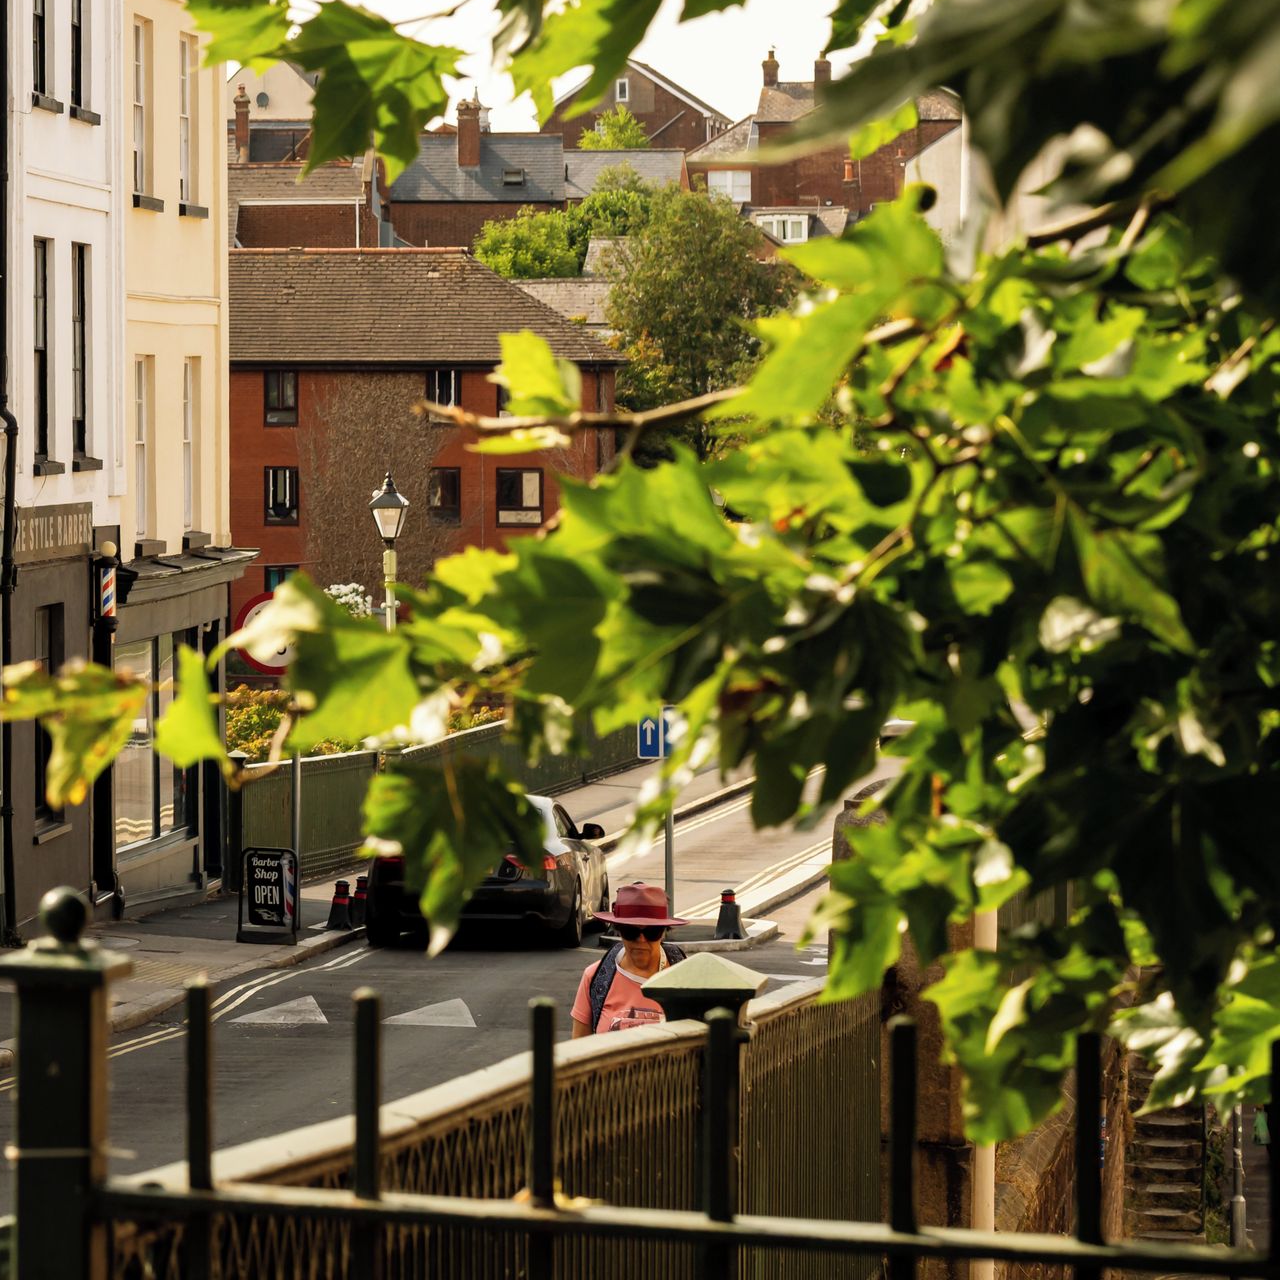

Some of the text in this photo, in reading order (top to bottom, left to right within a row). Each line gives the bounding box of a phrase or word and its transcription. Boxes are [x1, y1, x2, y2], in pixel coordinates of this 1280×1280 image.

[30, 516, 54, 550] STYLE
[58, 512, 92, 546] BARBERS
[252, 857, 280, 866] Barber
[254, 867, 278, 882] Shop
[254, 885, 280, 904] OPEN
